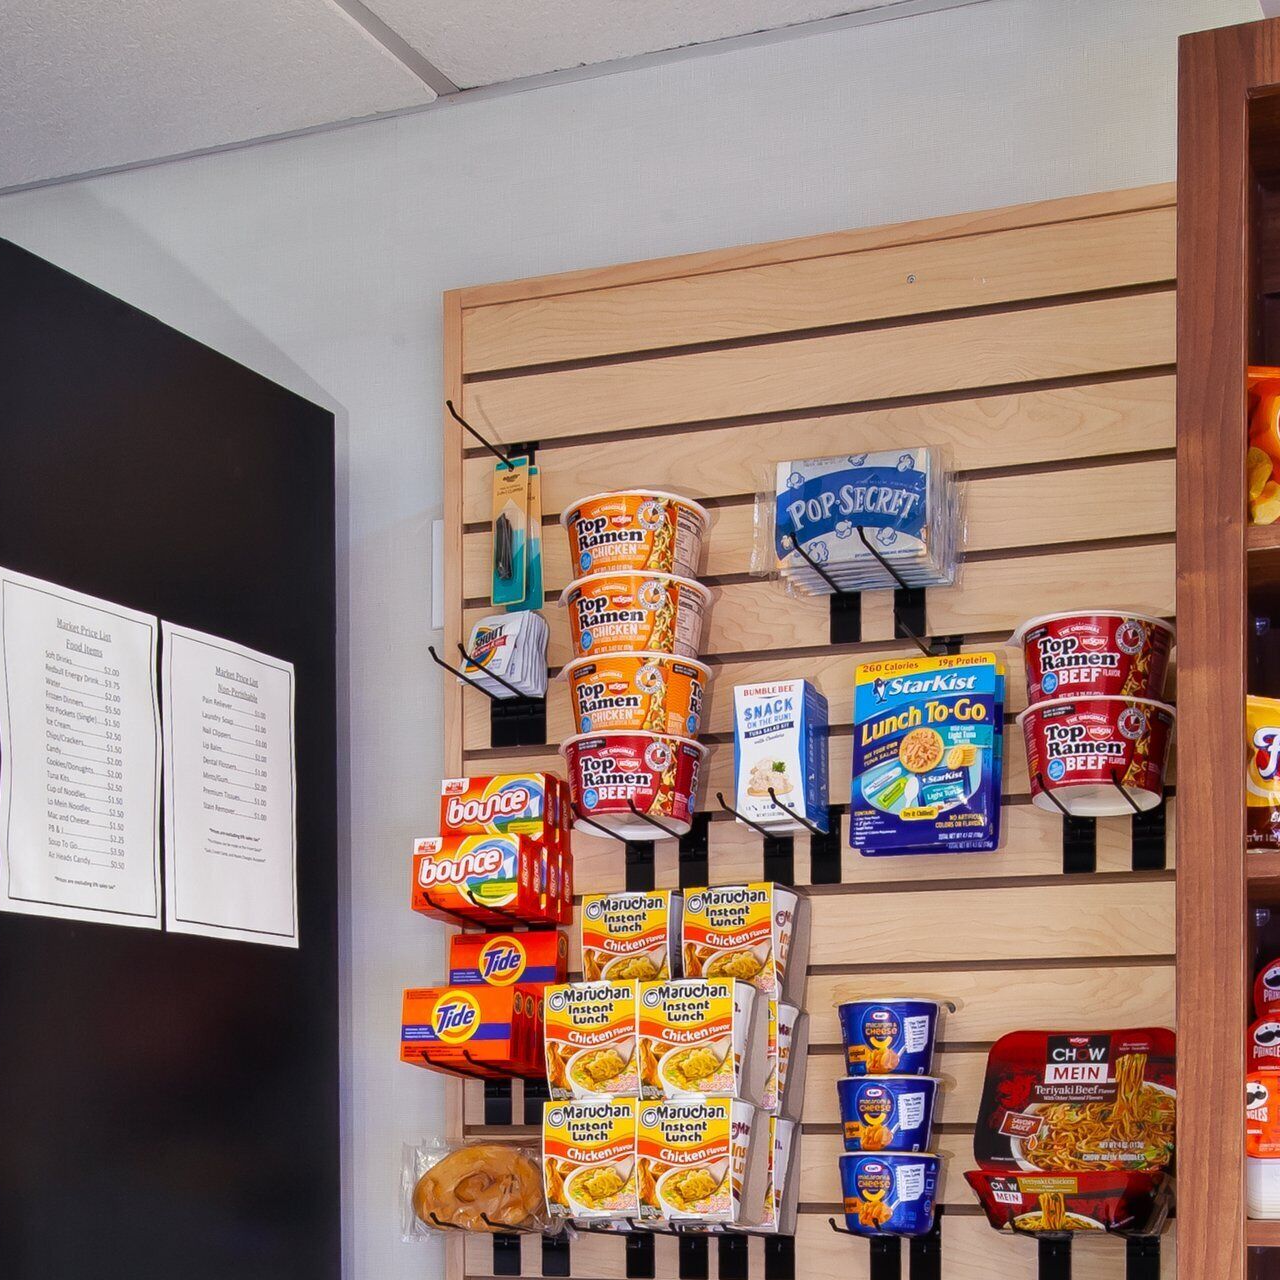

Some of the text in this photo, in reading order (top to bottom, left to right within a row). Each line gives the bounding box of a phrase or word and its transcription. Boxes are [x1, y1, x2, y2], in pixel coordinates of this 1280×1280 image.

[576, 517, 607, 536] Top
[579, 531, 643, 550] Ramen
[592, 544, 637, 558] CHICKEN
[57, 618, 111, 642] Market Price List
[66, 639, 103, 658] Food Items
[1039, 637, 1077, 654] Top
[885, 662, 919, 670] Calories
[938, 656, 987, 667] 19g Protein
[1042, 654, 1119, 673] Ramen
[65, 669, 83, 682] Energy
[84, 675, 98, 684] Drink
[216, 666, 235, 682] Market
[236, 674, 248, 684] Price
[1059, 668, 1101, 684] BEEF
[890, 674, 975, 695] StarKist
[744, 687, 776, 696] BUMBLE
[744, 701, 793, 720] SNACK
[760, 719, 772, 727] THE
[773, 714, 791, 724] RUN!
[862, 699, 986, 746] Lunch To-Go
[580, 758, 614, 772] Top
[583, 773, 650, 787] Ramen
[599, 787, 636, 799] BEEF
[70, 815, 89, 825] Cheese
[421, 850, 500, 884] bounce
[702, 890, 767, 905] Maruchan
[600, 898, 664, 912] Maruchan
[706, 906, 749, 917] Instant
[604, 913, 646, 923] Instant
[710, 918, 745, 926] Lunch
[609, 924, 642, 932] Lunch
[604, 939, 646, 951] Chicken
[706, 933, 749, 945] Chicken
[659, 986, 729, 999] Maruchan
[663, 1002, 709, 1011] Instant
[436, 1006, 475, 1034] Tide
[668, 1012, 704, 1021] Lunch
[662, 1030, 708, 1041] Chicken
[1053, 1048, 1105, 1061] CHOW
[1054, 1067, 1100, 1079] MEIN
[1035, 1085, 1098, 1095] Teriyaki Beef
